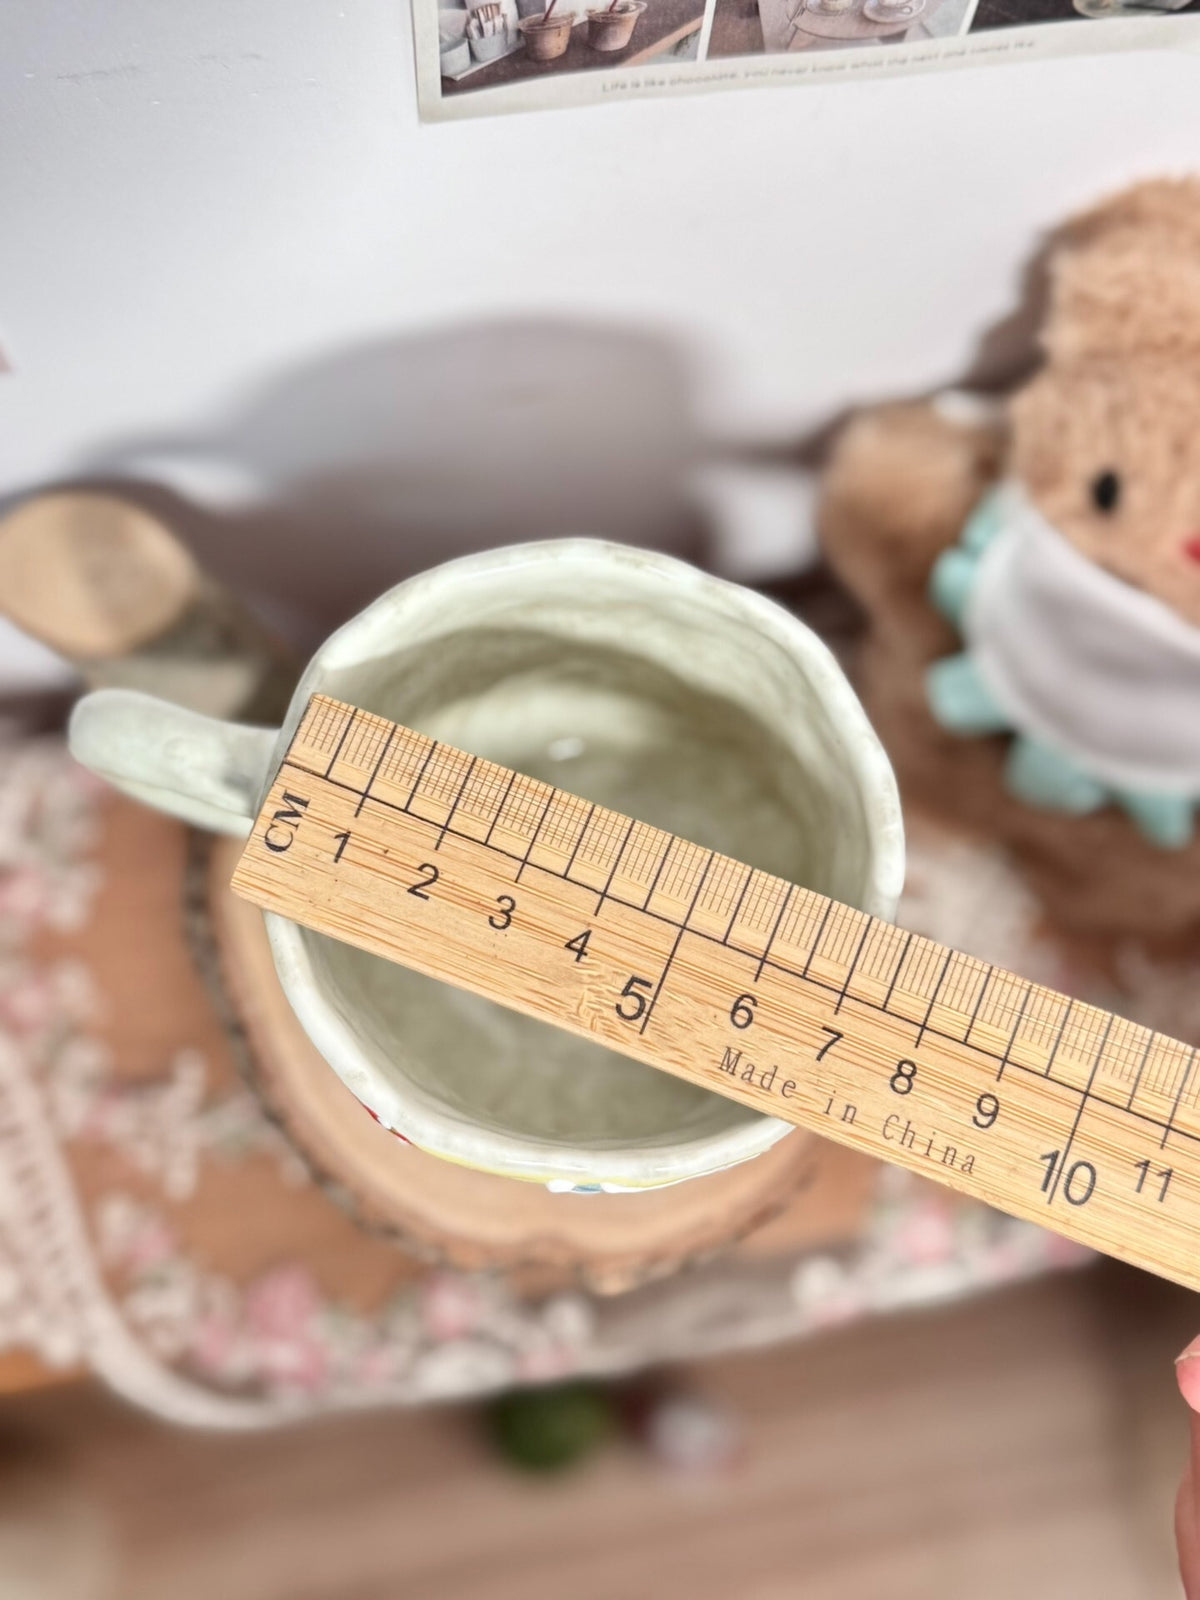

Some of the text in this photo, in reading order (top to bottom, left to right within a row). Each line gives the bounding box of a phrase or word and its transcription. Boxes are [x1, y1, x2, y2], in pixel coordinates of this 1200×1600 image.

[602, 80, 627, 93] Life
[630, 79, 641, 88] is
[644, 77, 666, 87] like
[264, 791, 311, 854] CM
[333, 830, 1175, 1208] 1 2 3 4 5 6 7 8 9 10 11
[717, 1047, 977, 1176] Made in China
